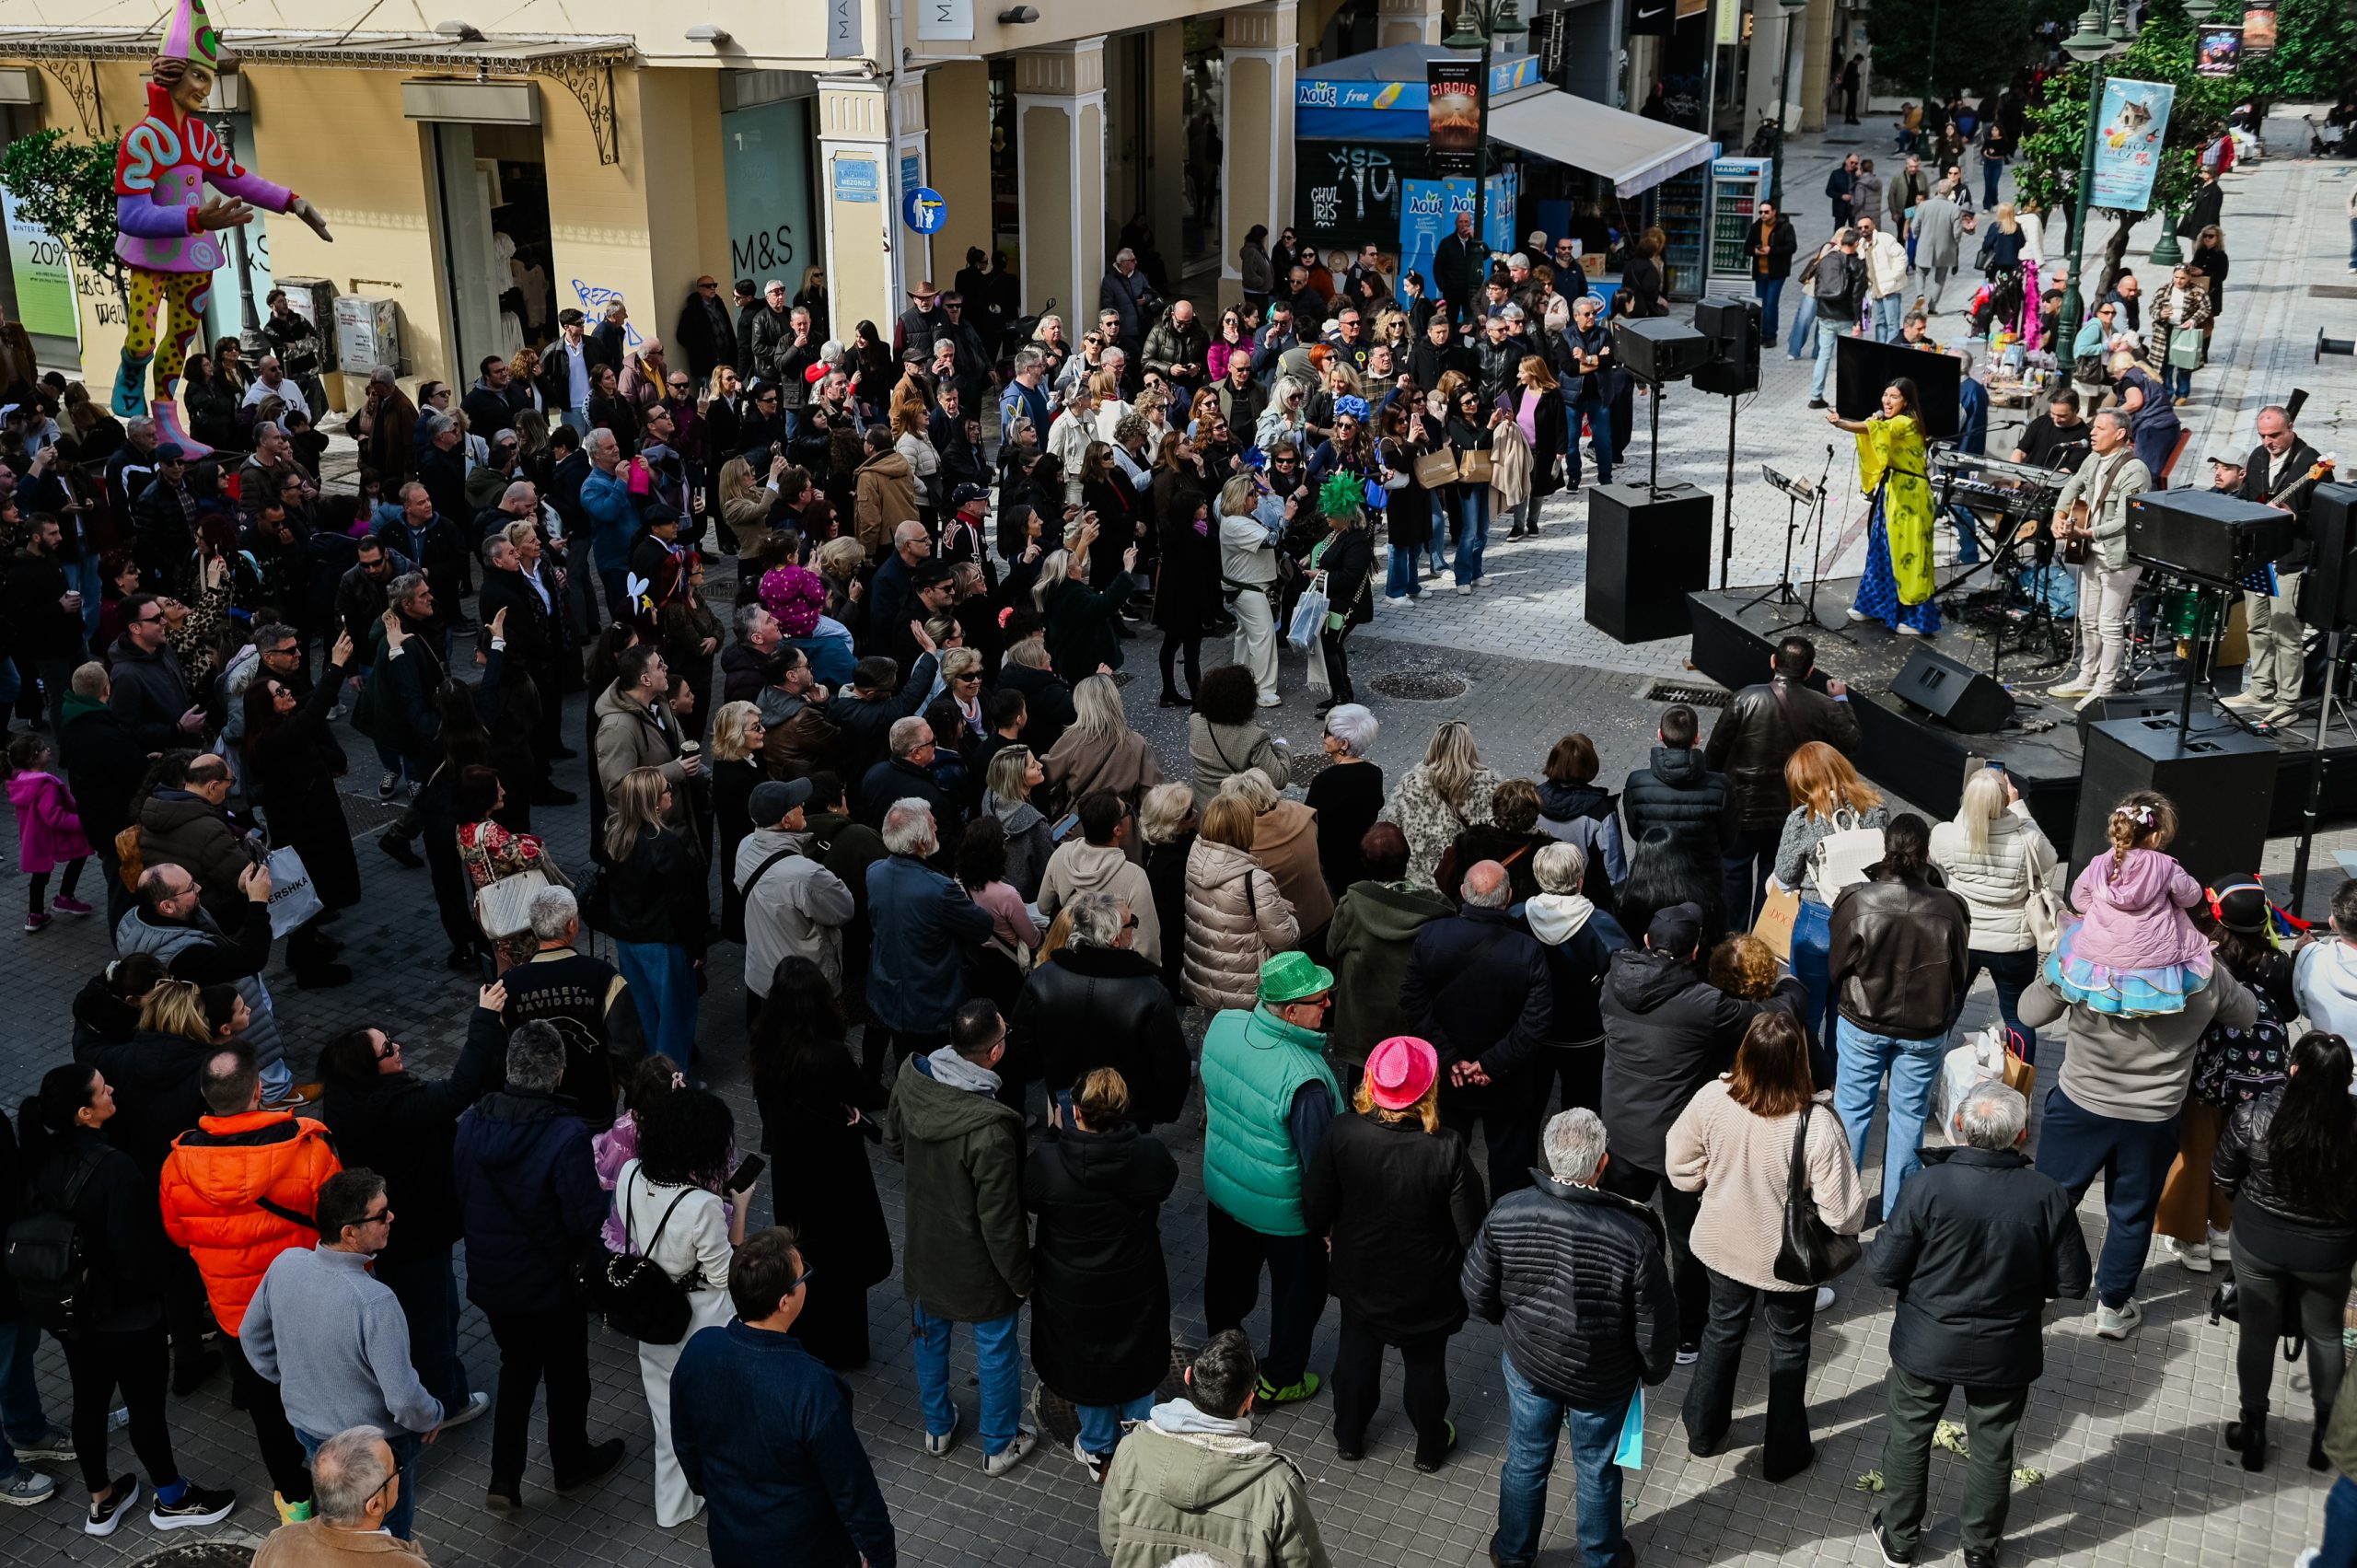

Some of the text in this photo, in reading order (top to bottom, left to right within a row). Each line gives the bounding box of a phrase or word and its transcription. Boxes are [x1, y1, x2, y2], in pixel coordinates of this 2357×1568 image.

[936, 0, 953, 22] M
[1342, 88, 1369, 105] free
[1430, 82, 1477, 97] CIRCUS
[13, 225, 35, 233] WINTER
[29, 240, 67, 267] 20%
[733, 225, 793, 279] M&S
[267, 876, 308, 904] ERSHKA
[521, 987, 587, 1002] HARLEY-
[517, 997, 595, 1013] DAVIDSON
